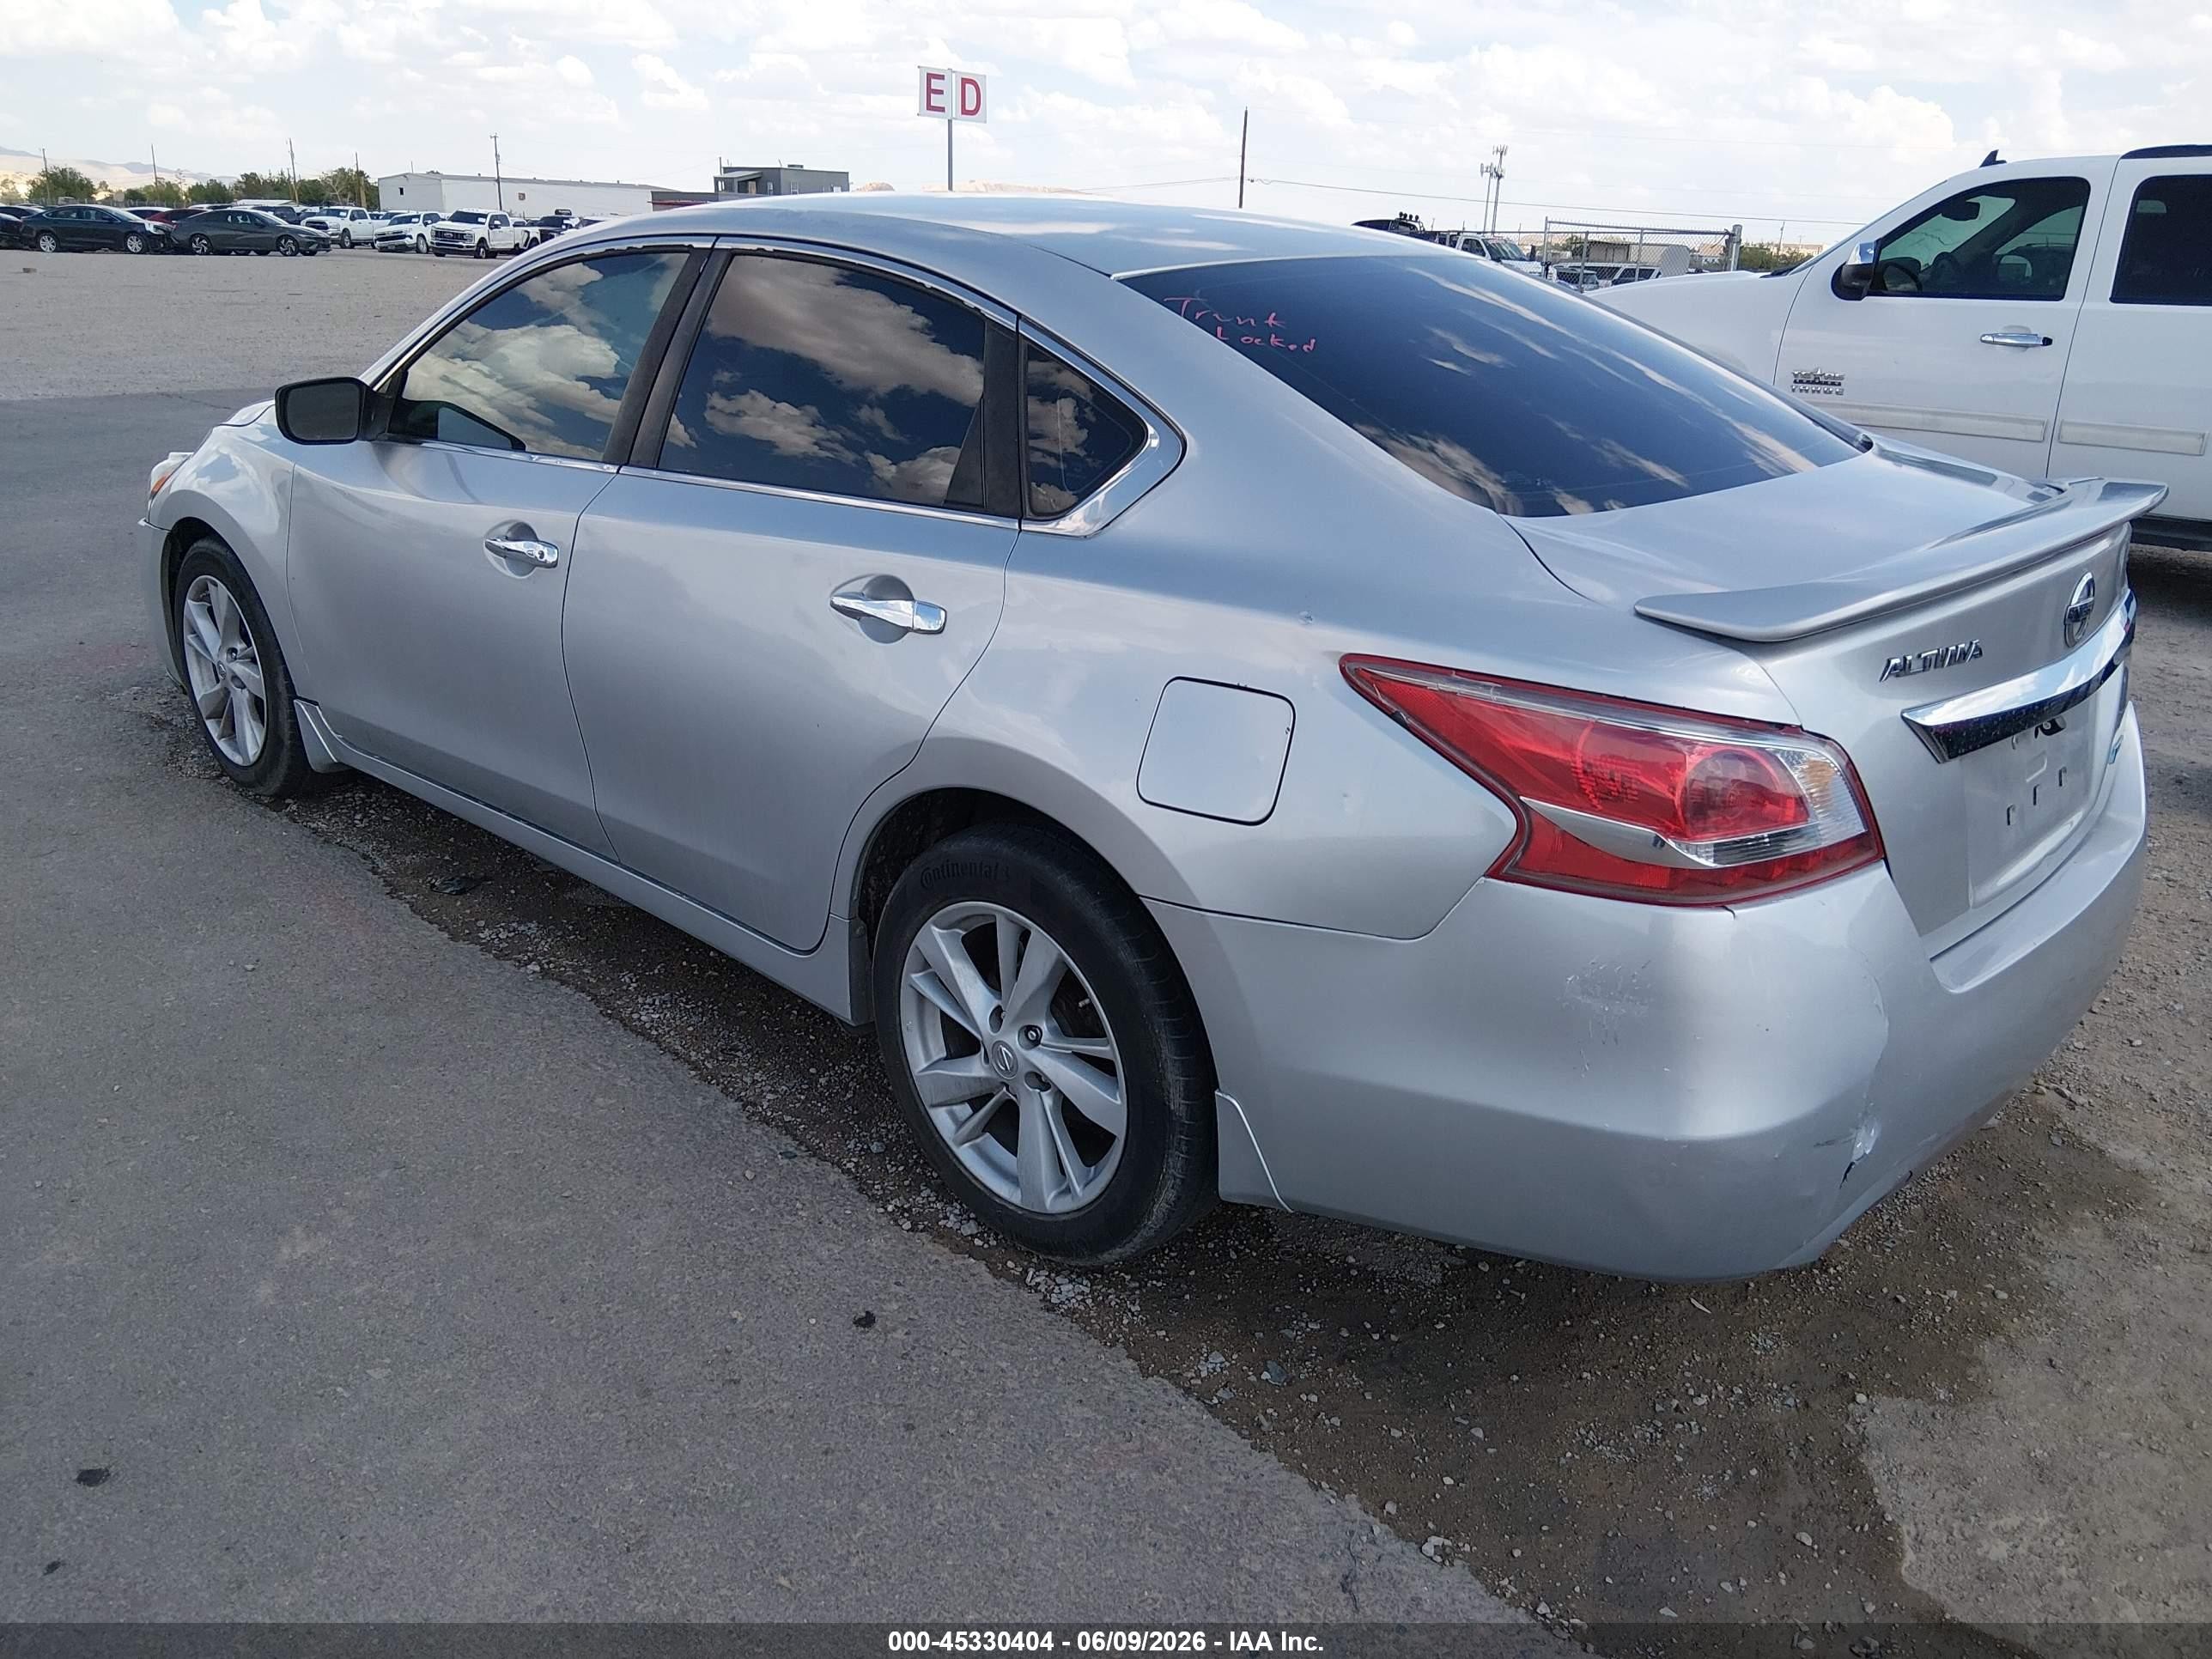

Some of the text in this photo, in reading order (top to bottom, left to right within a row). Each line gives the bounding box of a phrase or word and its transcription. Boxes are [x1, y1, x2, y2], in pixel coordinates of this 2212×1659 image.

[926, 72, 981, 116] E D
[1879, 640, 1984, 683] ALTIMA
